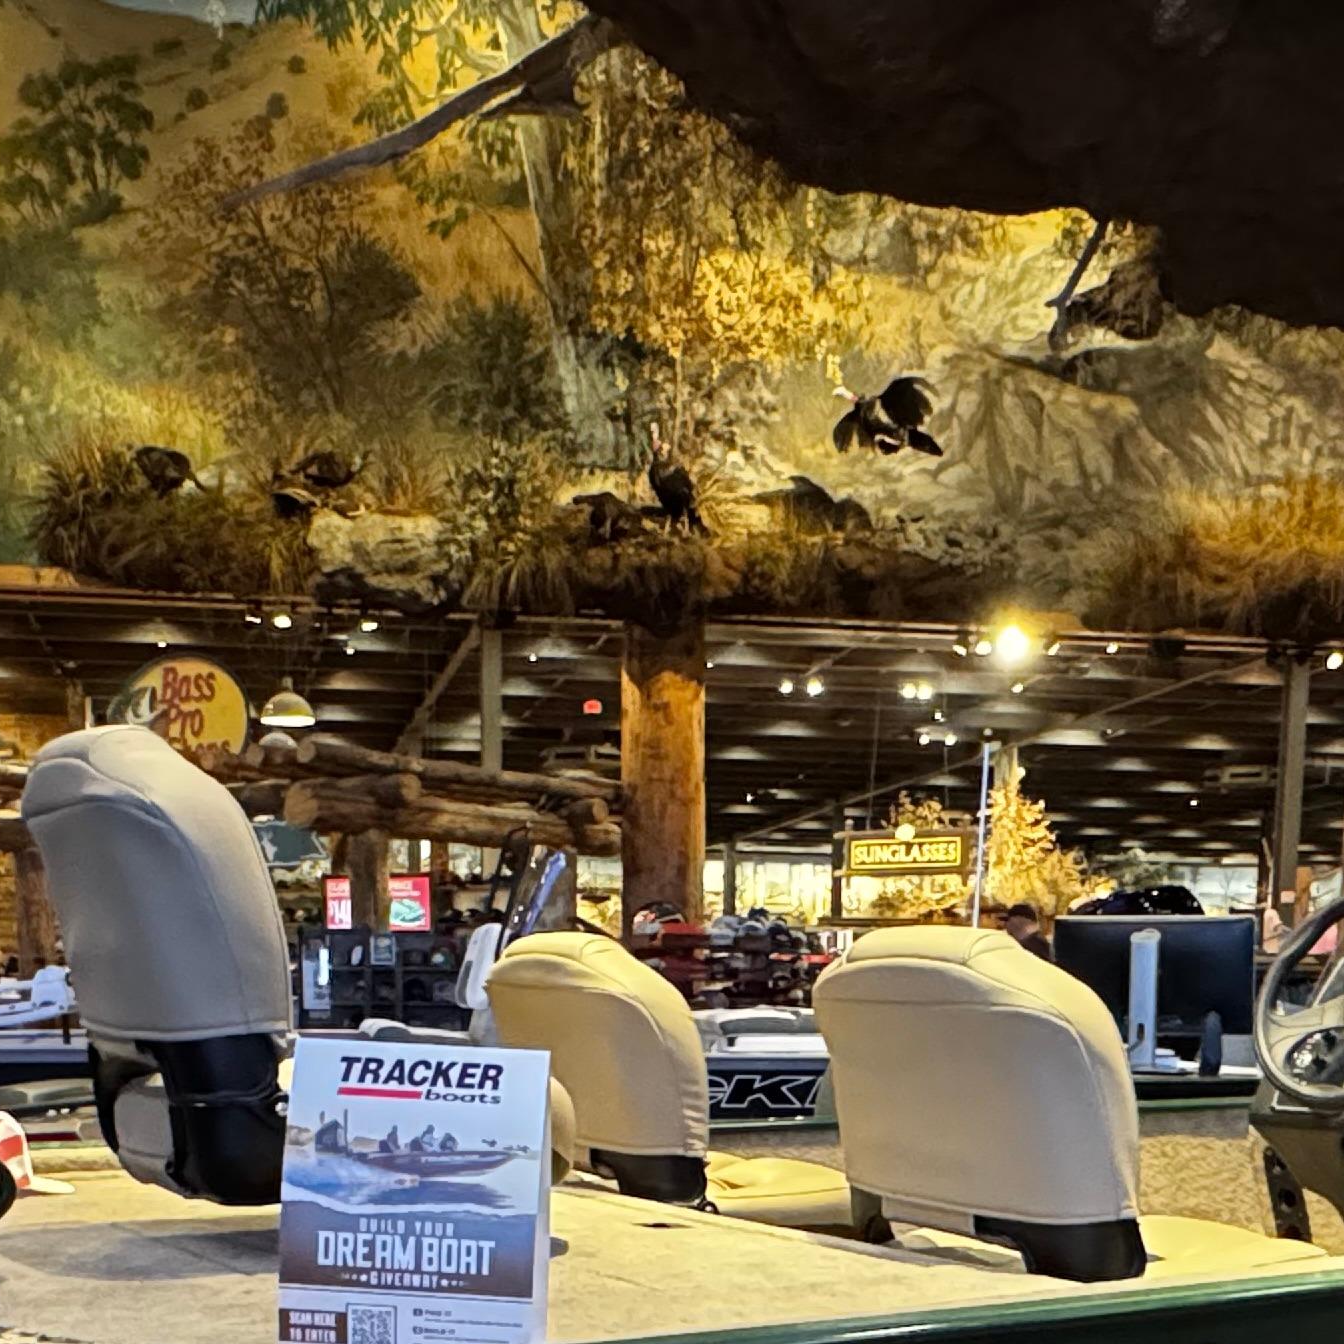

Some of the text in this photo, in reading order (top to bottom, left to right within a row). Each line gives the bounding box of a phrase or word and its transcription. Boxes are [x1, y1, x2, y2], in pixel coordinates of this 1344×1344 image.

[162, 666, 216, 703] Bass
[167, 703, 205, 739] Pro
[855, 842, 957, 864] SUNGLASSES
[339, 1056, 504, 1091] TRACKER
[424, 1088, 502, 1105] boats
[359, 1216, 455, 1238] BUILD YOUR
[317, 1230, 497, 1277] DREAM BOAT
[369, 1270, 440, 1290] GIVEAWAY
